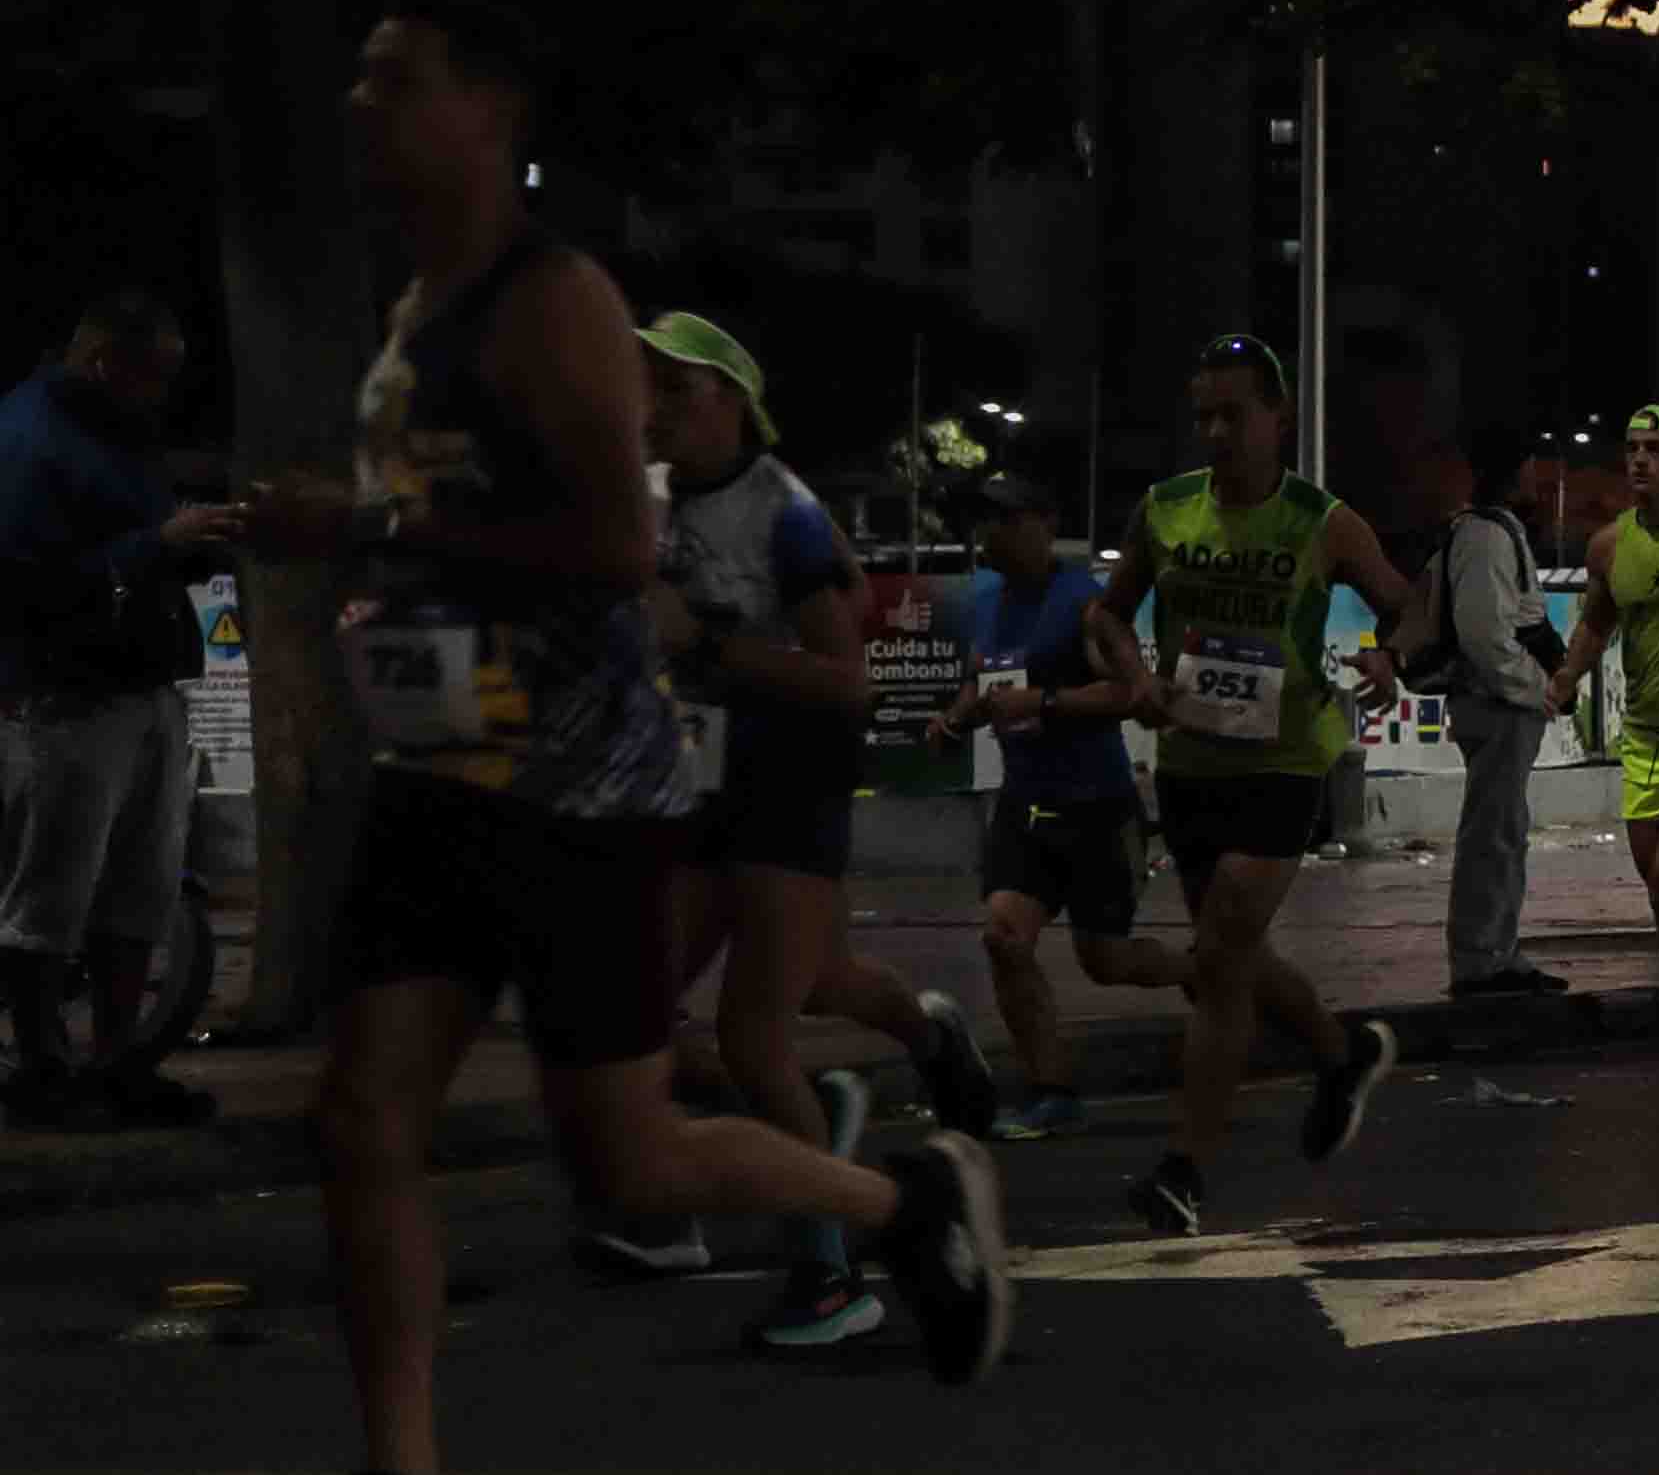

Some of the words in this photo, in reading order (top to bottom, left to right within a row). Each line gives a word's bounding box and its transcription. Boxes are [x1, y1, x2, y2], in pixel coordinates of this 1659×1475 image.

[1172, 543, 1296, 578] ADOLFO
[932, 638, 954, 657] tu
[1199, 669, 1260, 701] 951
